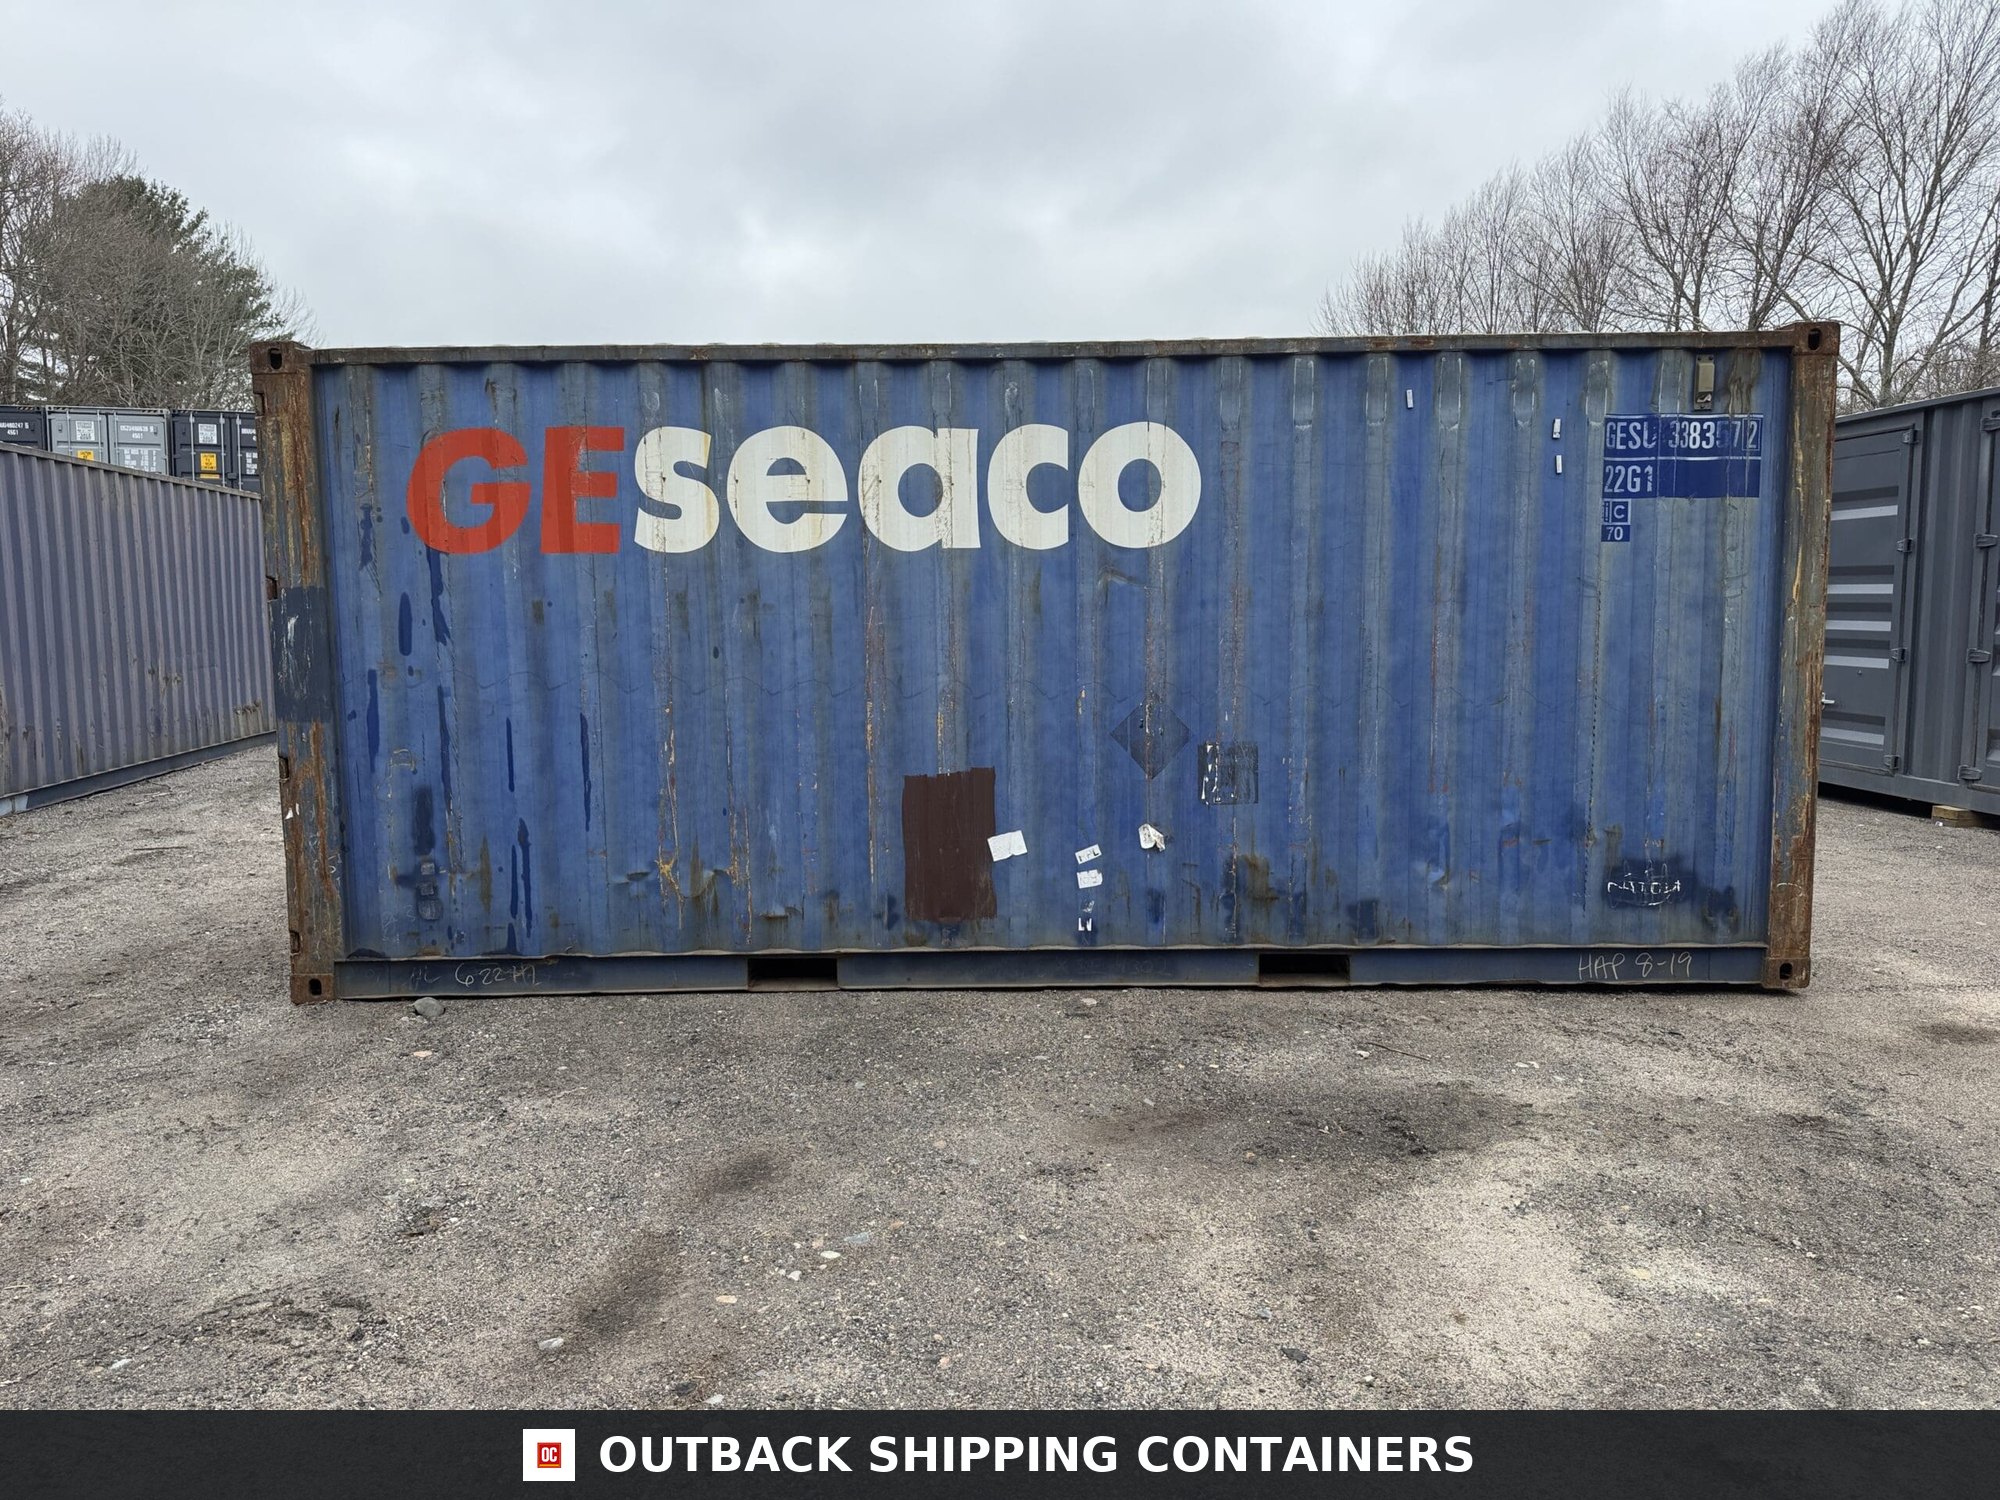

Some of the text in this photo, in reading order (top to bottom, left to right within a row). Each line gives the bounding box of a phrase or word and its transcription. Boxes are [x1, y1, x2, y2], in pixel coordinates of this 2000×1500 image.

[1605, 420, 1656, 449] GESU
[1604, 465, 1653, 492] 22G1
[1606, 526, 1624, 540] 70
